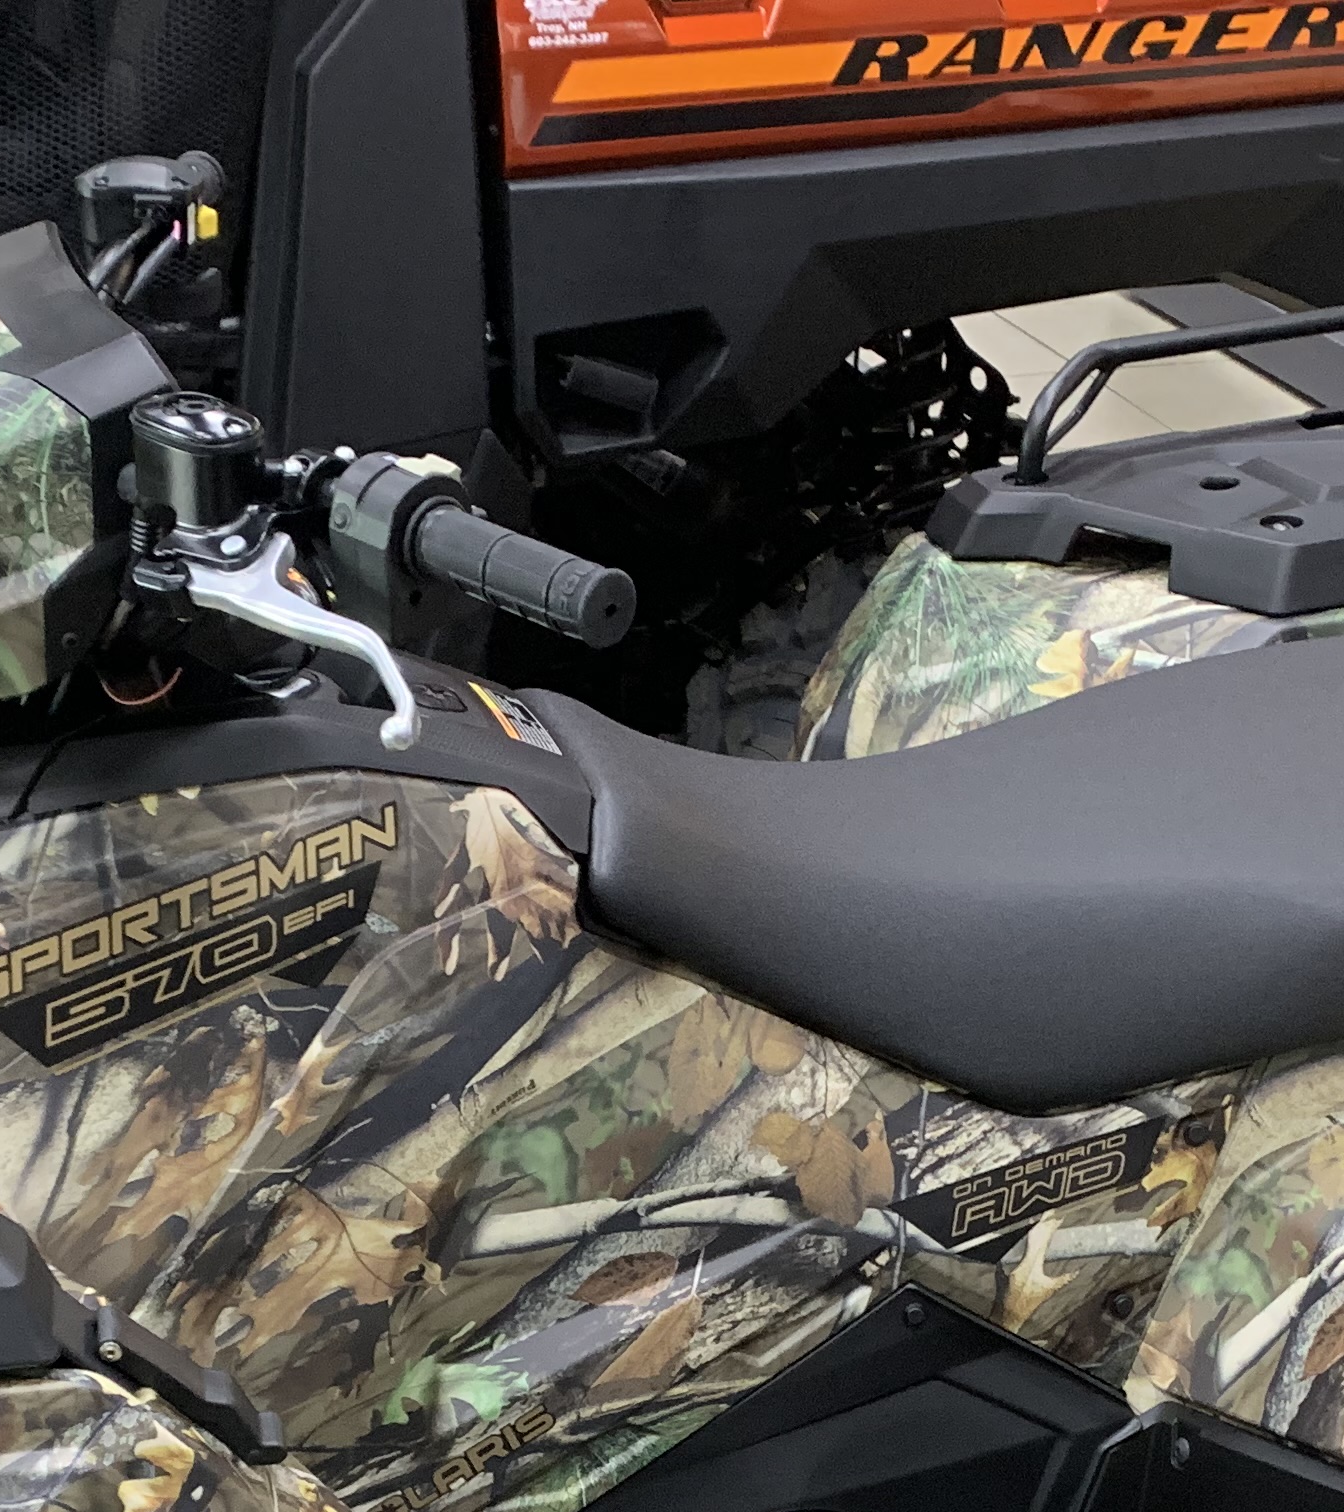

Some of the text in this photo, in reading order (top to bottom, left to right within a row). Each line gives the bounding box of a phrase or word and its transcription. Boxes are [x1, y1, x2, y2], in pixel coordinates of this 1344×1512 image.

[44, 889, 355, 1048] 570 EFI
[951, 1151, 1126, 1238] AWD
[952, 1132, 1127, 1199] ON DEMAND
